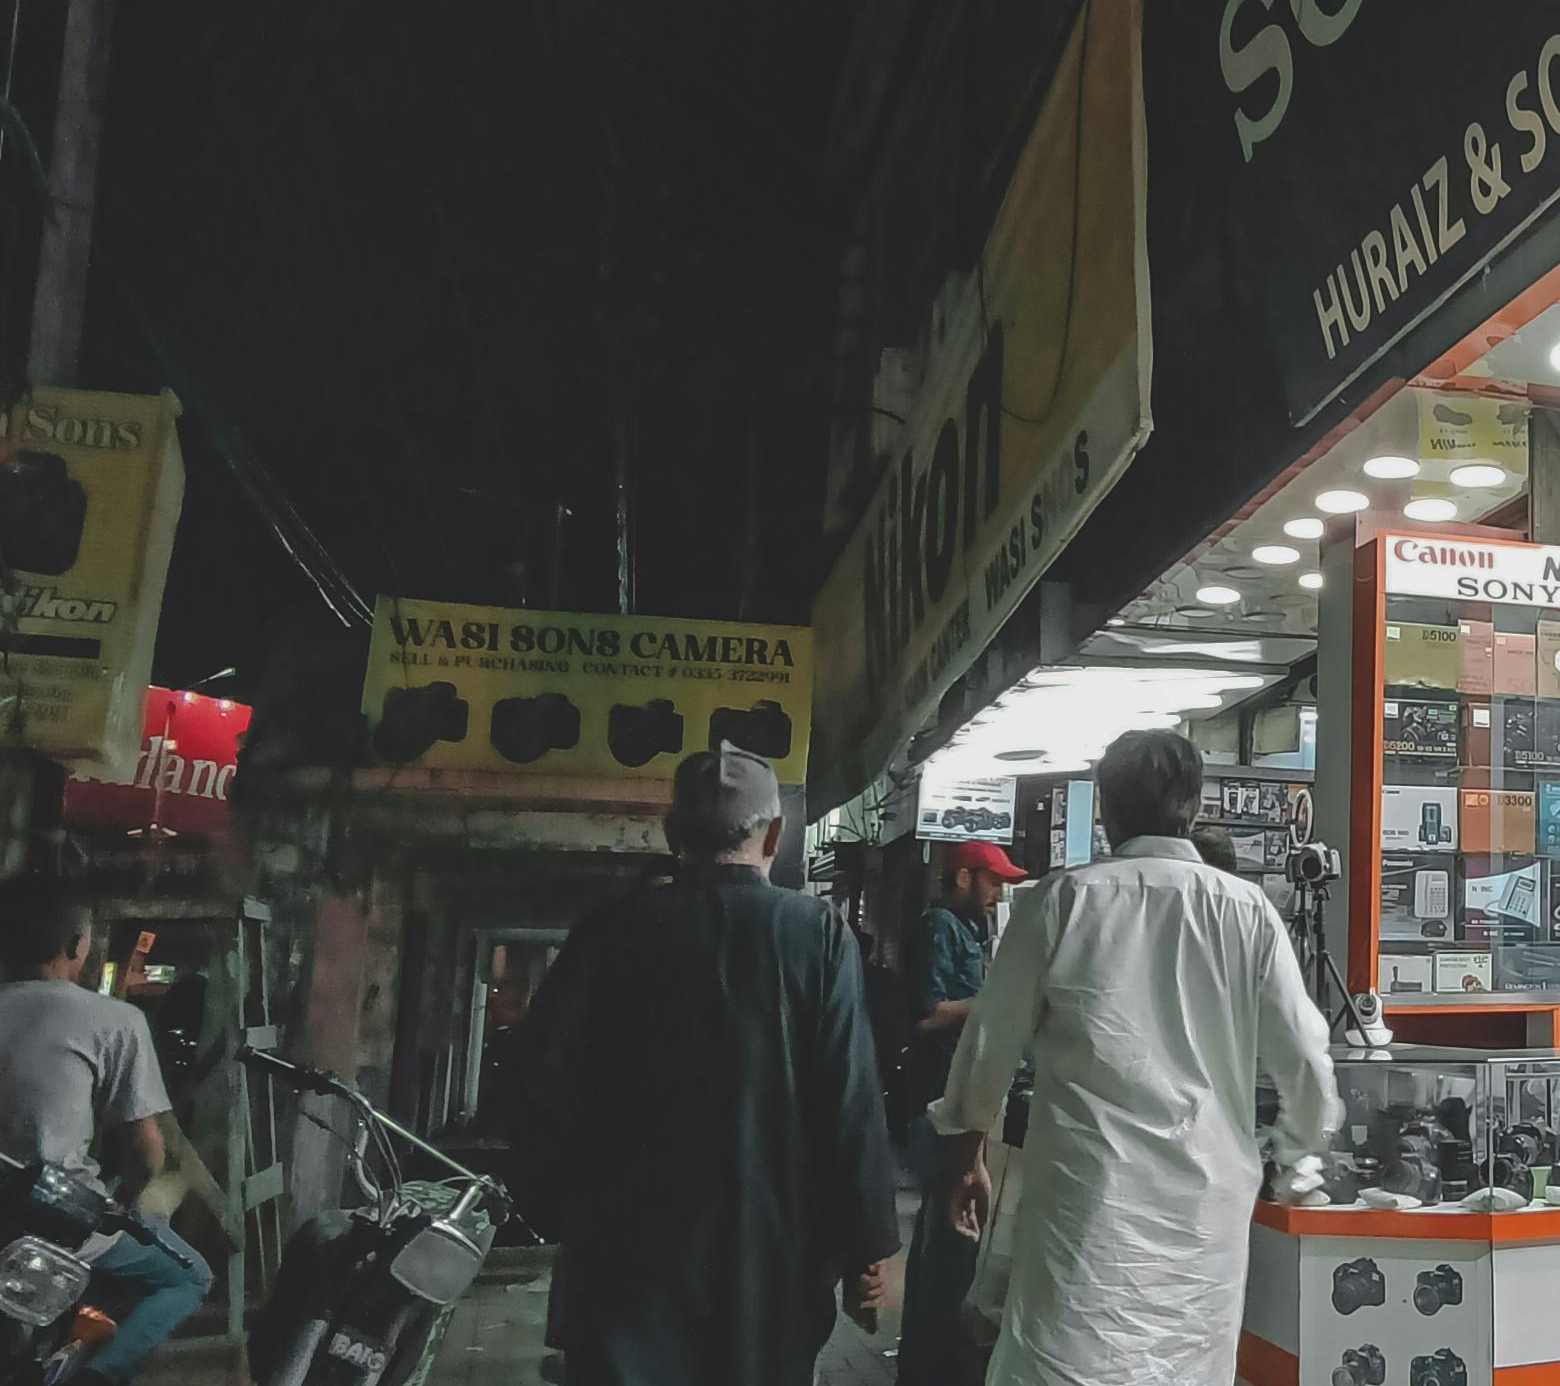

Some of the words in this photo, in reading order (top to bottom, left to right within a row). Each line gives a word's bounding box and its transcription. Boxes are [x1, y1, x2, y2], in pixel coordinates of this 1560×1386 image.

[1314, 154, 1468, 361] HURAIZ
[1463, 120, 1512, 216] &
[26, 403, 143, 449] Sons
[984, 515, 1027, 612] WASI
[1393, 539, 1494, 569] Canon
[388, 616, 501, 652] WASI
[510, 624, 622, 659] SONS
[630, 630, 796, 667] CAMERA
[1422, 630, 1457, 643] D5100
[389, 651, 432, 666] SELL
[438, 655, 449, 667] &
[454, 655, 570, 673] PURCHASING
[582, 662, 664, 677] CONTACT
